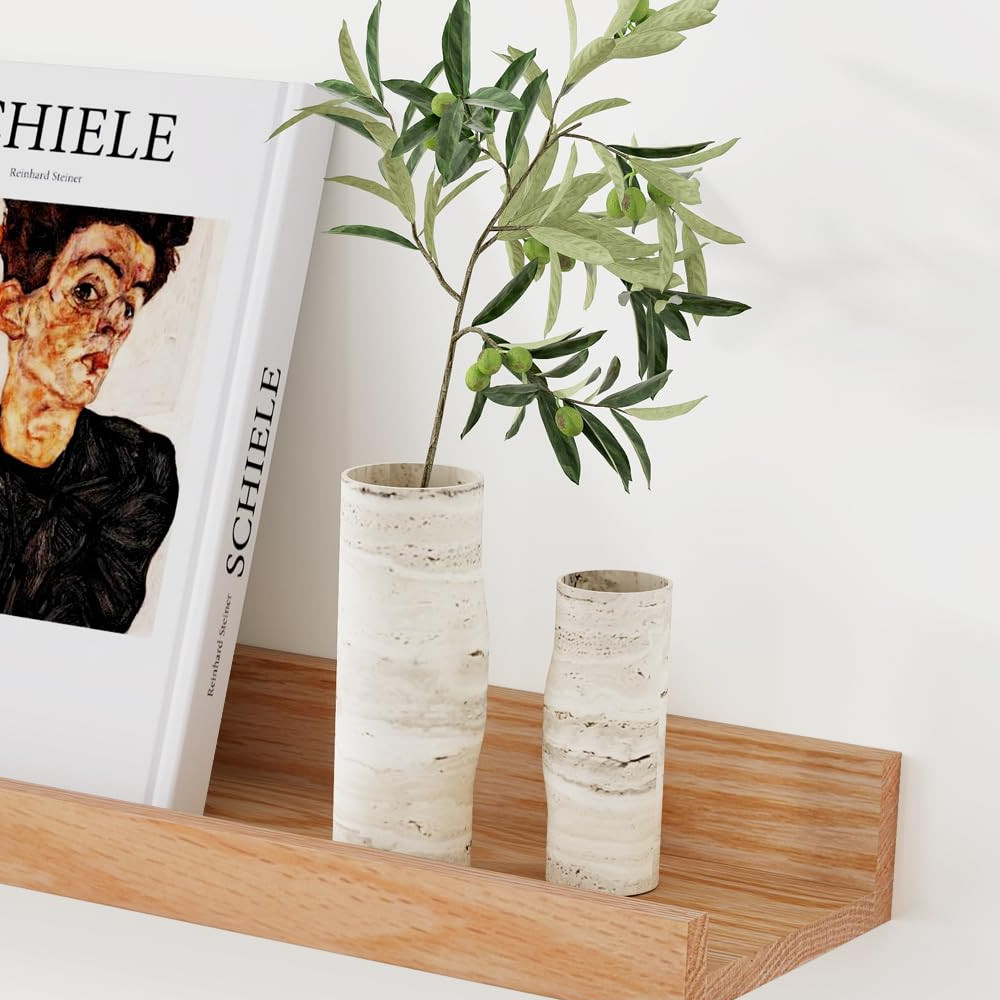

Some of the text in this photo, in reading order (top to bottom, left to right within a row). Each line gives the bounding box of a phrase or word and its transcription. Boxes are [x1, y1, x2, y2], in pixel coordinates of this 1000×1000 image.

[9, 167, 82, 183] Reinhard Steiner
[225, 366, 282, 578] SCHIELE
[207, 592, 232, 697] Reinhard Steiner
